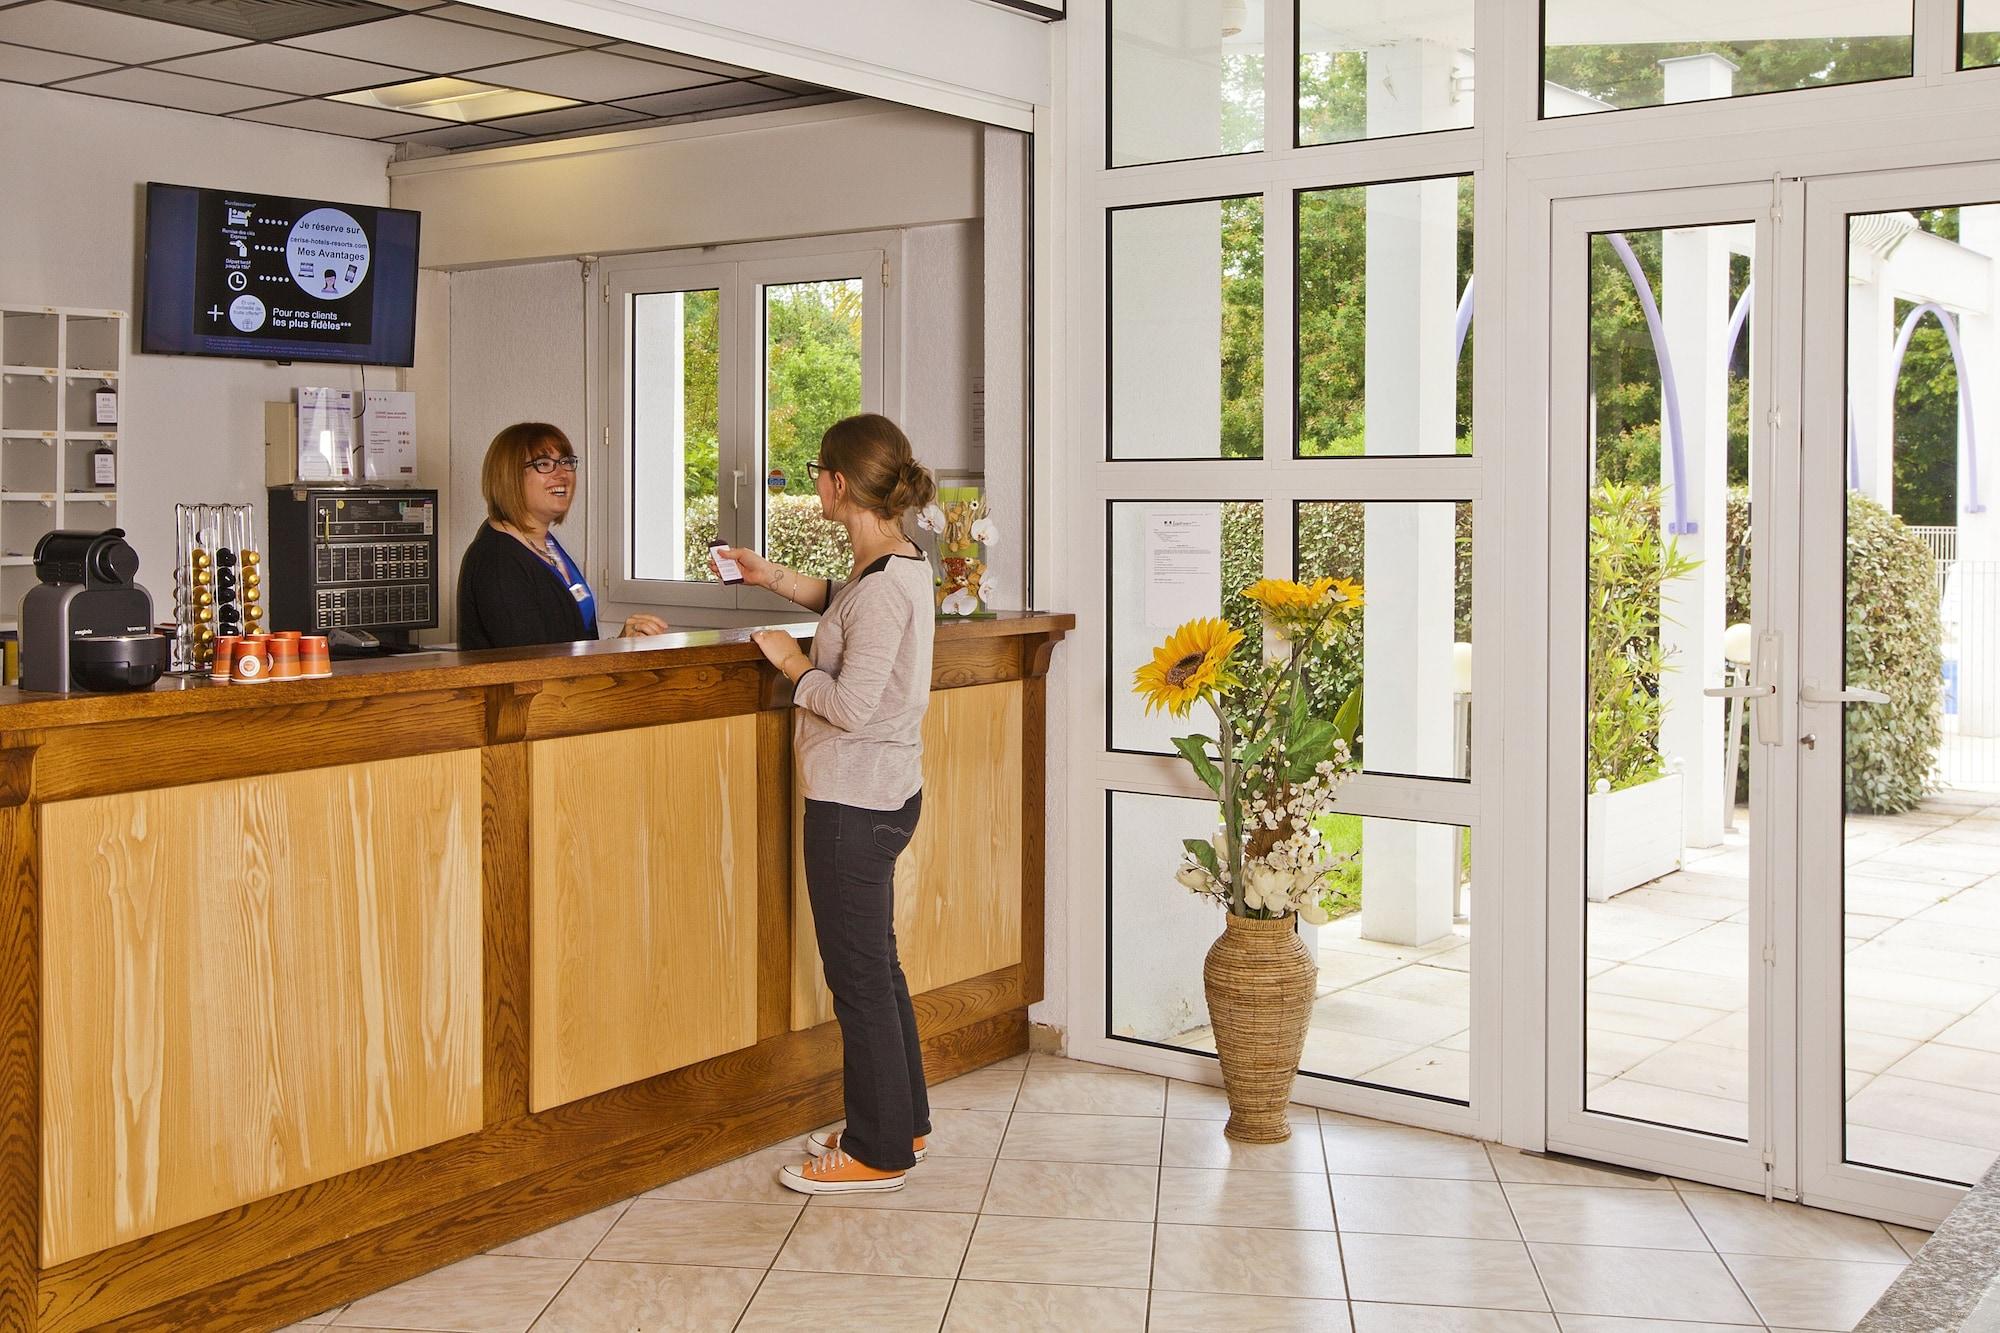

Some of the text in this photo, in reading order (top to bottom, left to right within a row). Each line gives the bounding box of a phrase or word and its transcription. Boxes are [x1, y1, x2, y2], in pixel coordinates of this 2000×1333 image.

[299, 221, 309, 229] Je
[312, 222, 344, 233] réserve
[290, 237, 368, 249] cerise-hotels-resorts.com
[297, 247, 365, 261] Mes Avantages
[273, 307, 292, 317] Pour
[295, 311, 310, 319] nos
[312, 311, 338, 320] clients
[273, 317, 286, 327] les
[289, 319, 309, 329] plus
